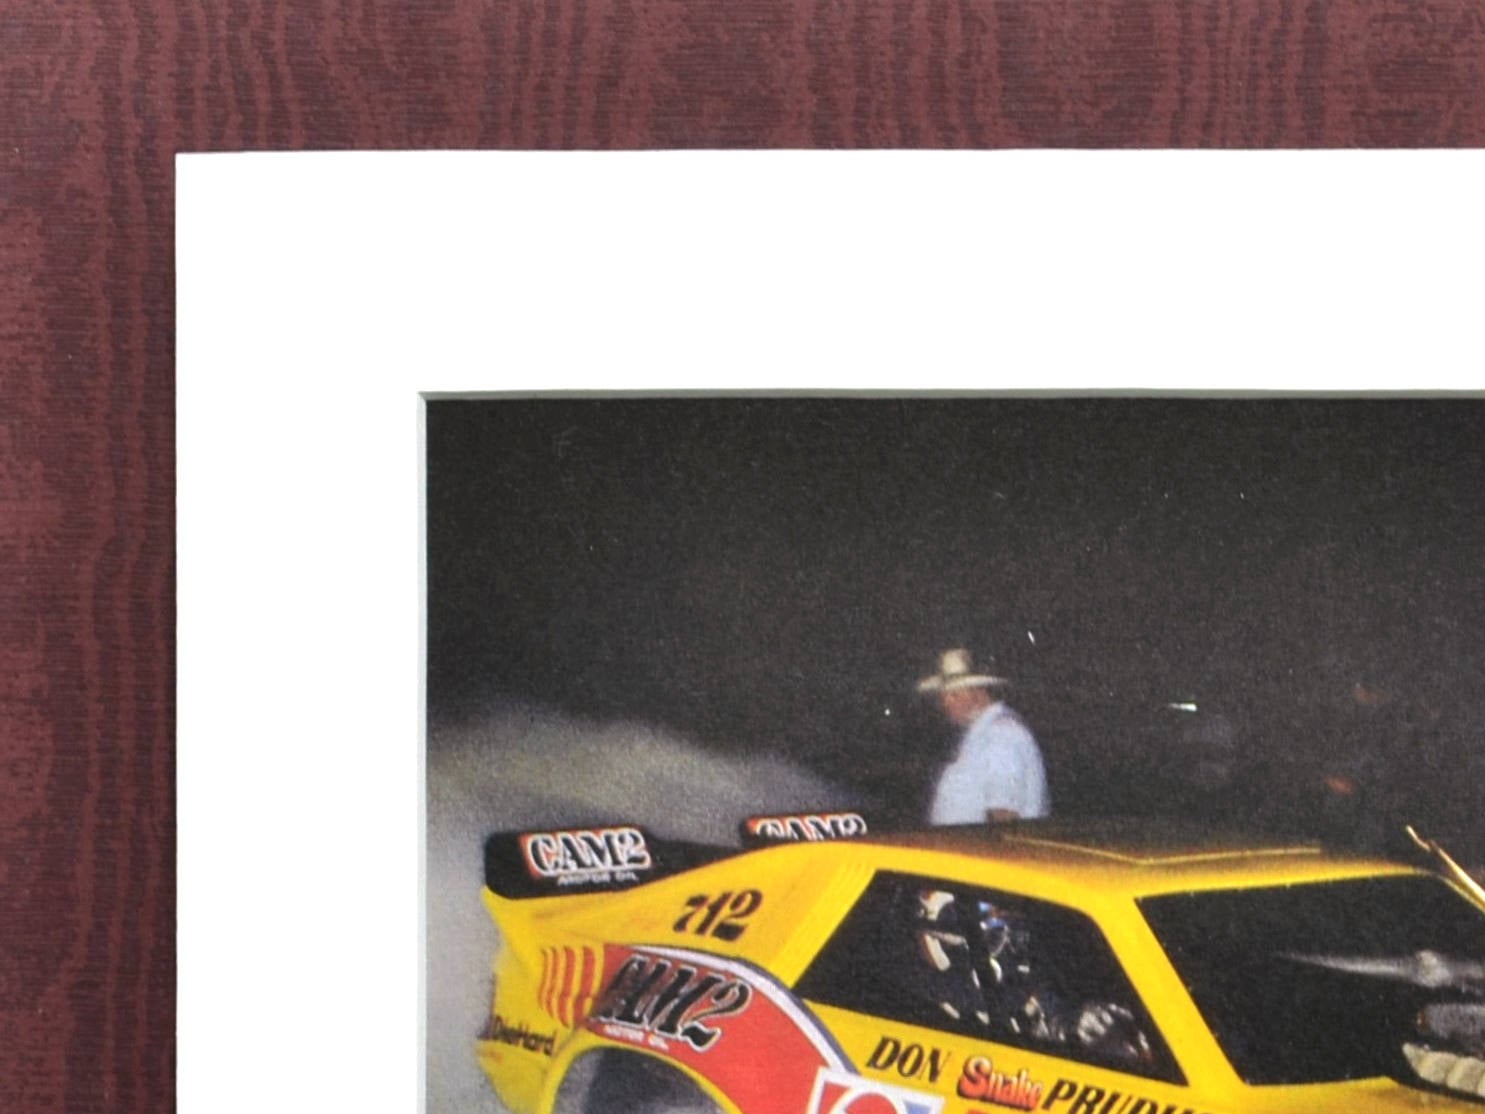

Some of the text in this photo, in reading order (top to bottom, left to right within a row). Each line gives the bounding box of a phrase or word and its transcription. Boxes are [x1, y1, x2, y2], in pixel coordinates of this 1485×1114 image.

[527, 827, 651, 877] CAM2
[672, 889, 762, 942] 712
[866, 1036, 952, 1083] DON
[956, 1056, 1045, 1112] Snake
